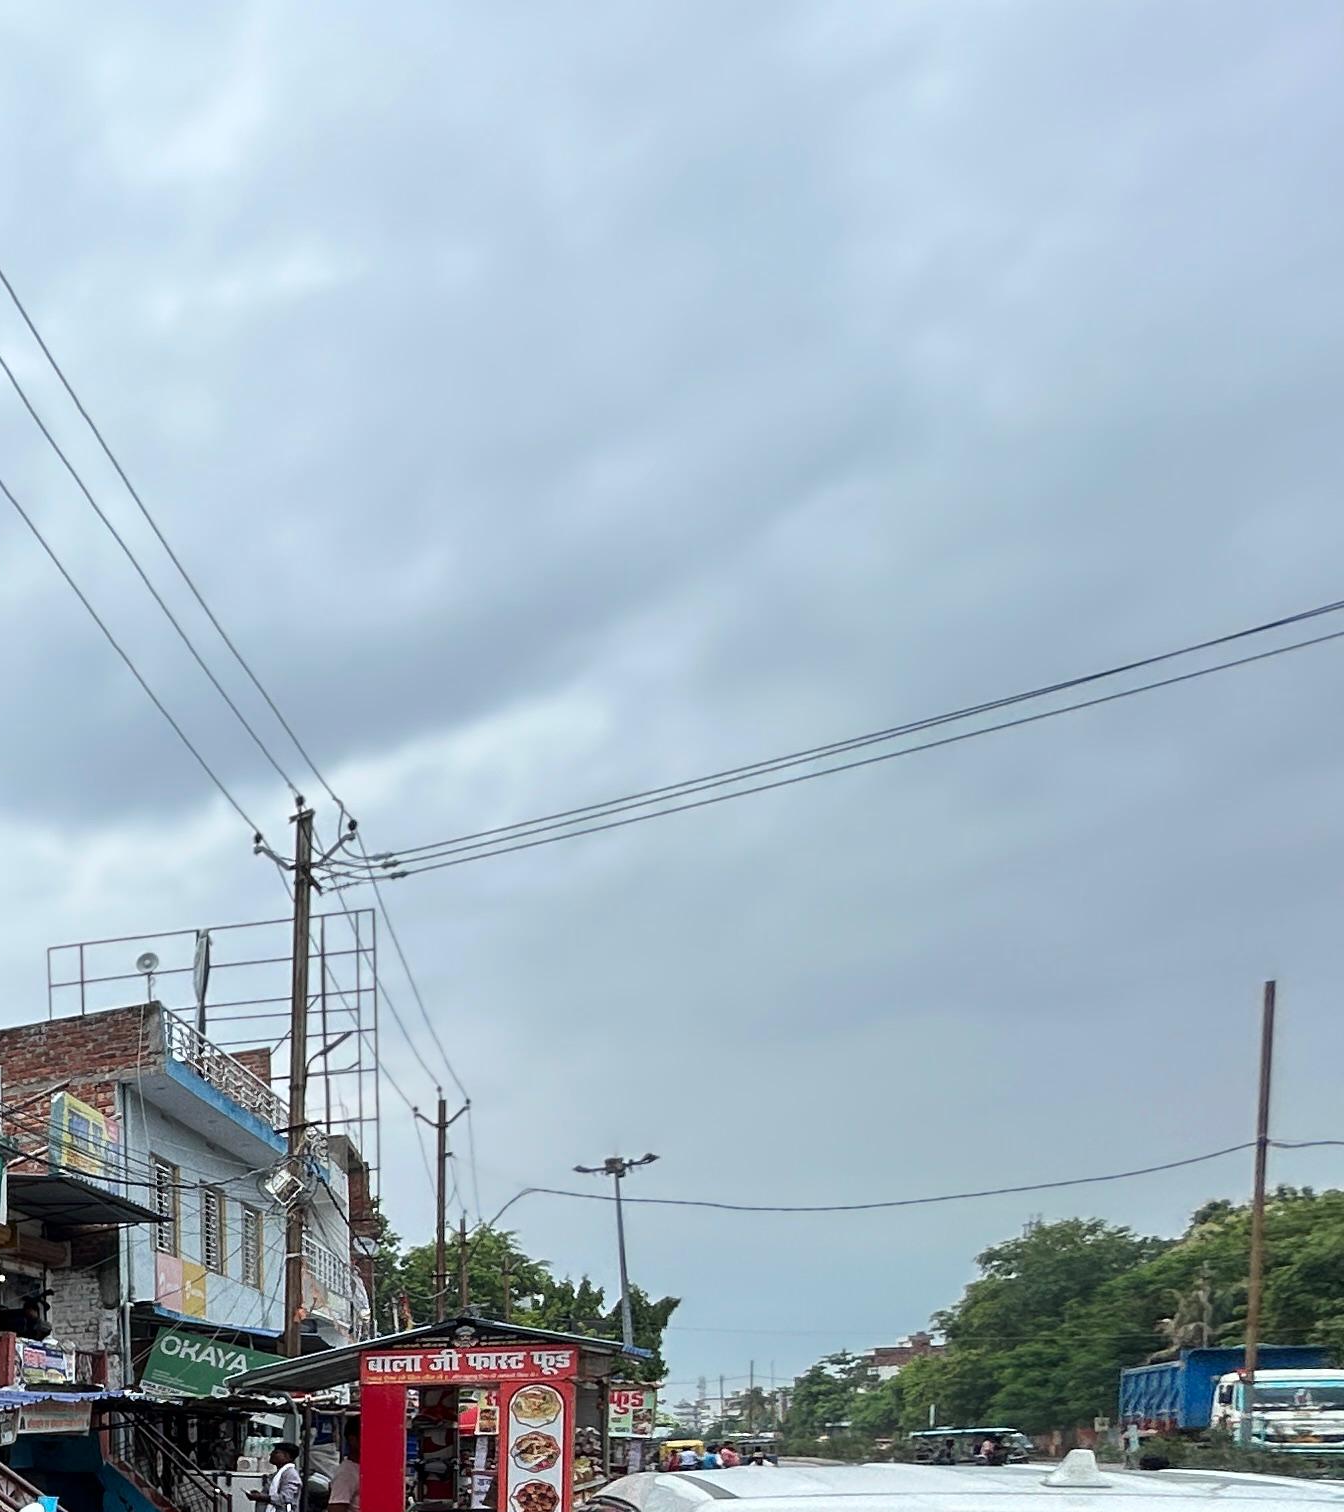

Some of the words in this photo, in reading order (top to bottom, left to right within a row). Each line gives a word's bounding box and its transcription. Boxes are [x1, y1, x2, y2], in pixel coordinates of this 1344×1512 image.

[160, 1335, 249, 1373] OKAYA
[365, 1354, 424, 1373] बाला
[427, 1349, 462, 1372] जी
[465, 1352, 527, 1370] फास्ट
[530, 1350, 574, 1375] फूड
